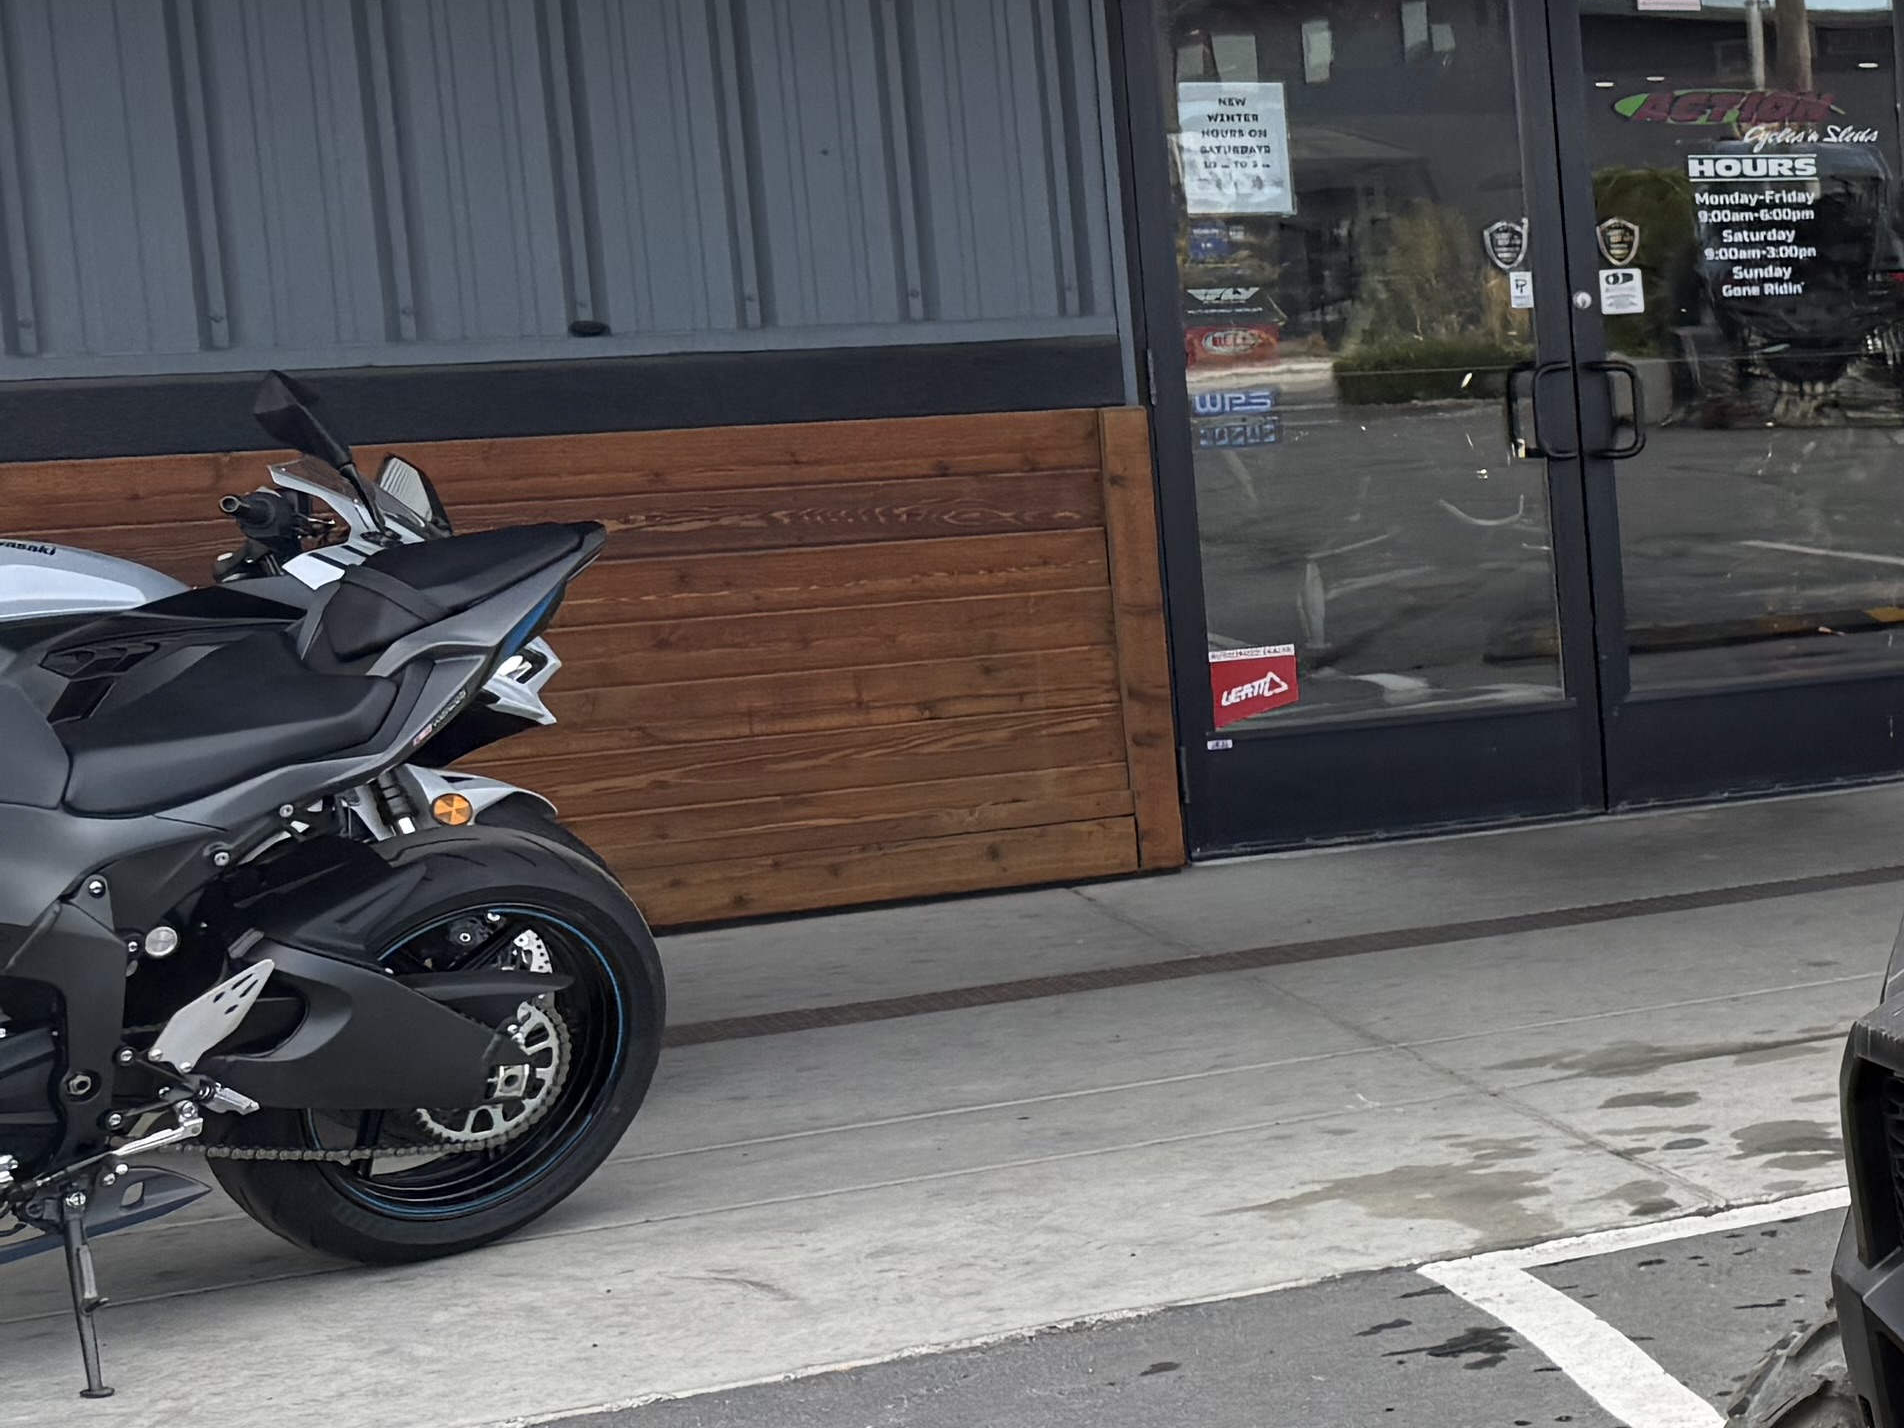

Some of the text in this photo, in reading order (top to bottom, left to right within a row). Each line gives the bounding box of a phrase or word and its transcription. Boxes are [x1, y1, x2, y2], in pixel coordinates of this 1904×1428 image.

[1218, 97, 1247, 107] NEW
[1629, 91, 1839, 122] ACTION
[1207, 113, 1259, 123] WINTER
[1201, 128, 1267, 138] HOURS ON
[1200, 145, 1271, 155] SATURDAYS
[1688, 158, 1817, 178] HOURS
[1694, 190, 1815, 206] Monday-Friday
[1698, 208, 1815, 223] 9:00am-6:00pm
[1722, 228, 1796, 243] Saturday
[1732, 265, 1792, 280] Sunday
[1722, 284, 1760, 298] Gone
[1194, 391, 1272, 413] WPS
